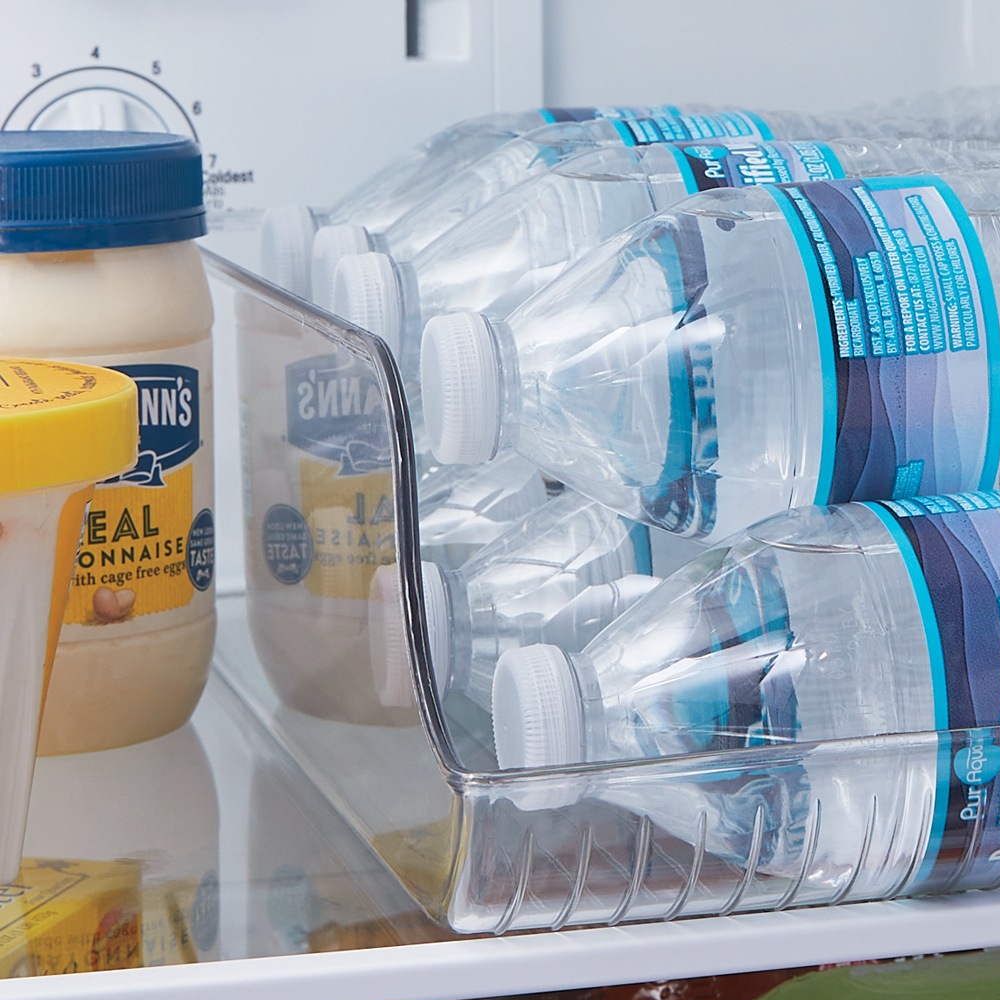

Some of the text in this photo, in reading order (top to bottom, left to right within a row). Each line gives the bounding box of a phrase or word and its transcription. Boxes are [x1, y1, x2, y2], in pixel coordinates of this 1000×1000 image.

[90, 46, 100, 60] 4
[31, 64, 41, 77] 3
[152, 60, 162, 75] 5
[192, 100, 202, 115] 6
[208, 153, 217, 168] 7
[930, 241, 946, 261] POSES
[868, 251, 883, 273] 60510
[887, 251, 903, 278] WATER
[938, 261, 951, 276] CAP
[824, 263, 841, 297] PURIFIED
[856, 257, 876, 303] EXCLUSIVELY
[895, 279, 907, 291] ON
[942, 276, 957, 302] SMALL
[954, 274, 967, 289] FOR
[910, 284, 923, 298] AT:
[866, 304, 880, 325] SOLD
[898, 292, 913, 325] REPORT
[913, 299, 925, 311] US
[832, 297, 850, 357] INGREDIENTS:
[846, 299, 864, 357] BICARBONATE.
[947, 302, 963, 348] WARNING:
[958, 290, 977, 347] PARTICULARLY
[916, 312, 931, 351] CONTACT
[871, 334, 883, 355] DIST.
[903, 334, 917, 352] FOR
[81, 504, 159, 546] EAL
[77, 536, 183, 569] ONNAISE
[190, 547, 214, 567] TASTE
[72, 560, 186, 588] ith cage free eggs
[960, 786, 983, 821] Pur
